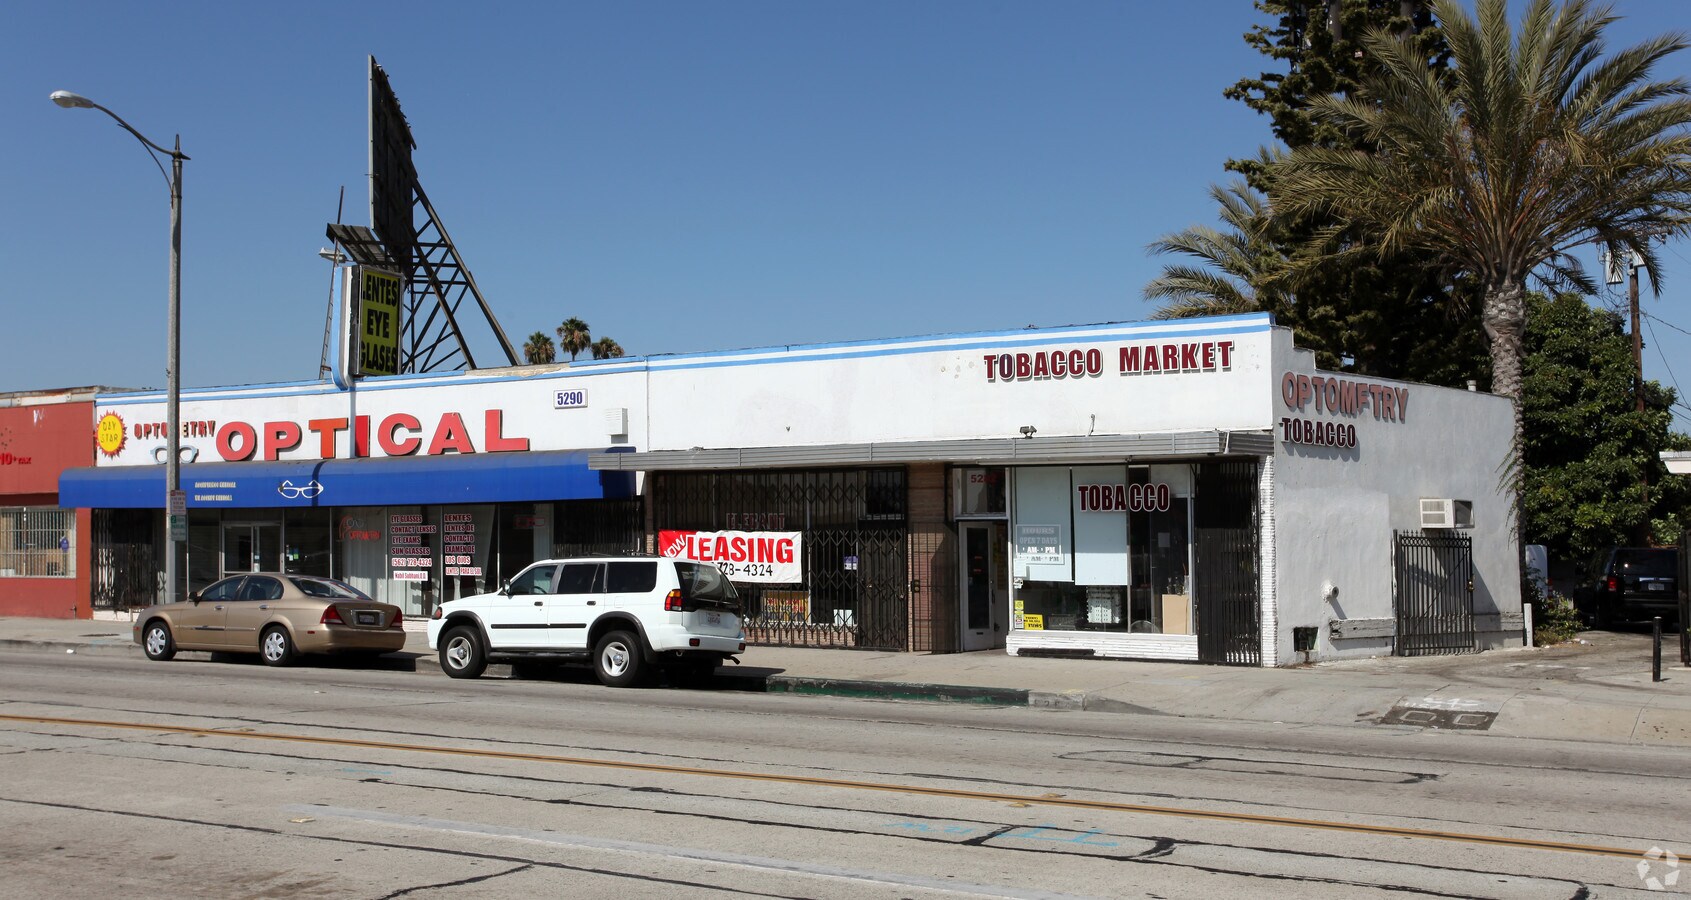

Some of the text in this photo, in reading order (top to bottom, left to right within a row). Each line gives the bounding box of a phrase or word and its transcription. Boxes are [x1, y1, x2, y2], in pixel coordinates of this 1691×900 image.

[366, 308, 390, 339] EYE
[984, 341, 1233, 382] TOBACCO MARKET
[557, 392, 583, 406] 5290
[102, 421, 117, 432] DAY
[134, 420, 216, 440] OPTOETRY
[215, 409, 530, 462] OPTICAL
[1280, 417, 1357, 449] TOBACCO
[100, 433, 119, 444] STAR
[1077, 483, 1170, 513] TOBACCO
[400, 514, 422, 523] GLASSES
[444, 513, 472, 522] LENTES
[390, 525, 437, 533] CONTACT LENSES
[445, 524, 475, 532] LENTES DE
[1022, 527, 1055, 535] HOURS
[392, 536, 421, 544] EYE EXAMS
[444, 534, 475, 542] CONTACTO
[1020, 537, 1058, 545] OPEN 7 DAYS
[391, 547, 430, 555] SUN GLASSES
[445, 545, 475, 553] EXAMEN DE
[687, 536, 794, 564] LEASING
[407, 558, 432, 567] 728-4324
[445, 556, 456, 564] LOS
